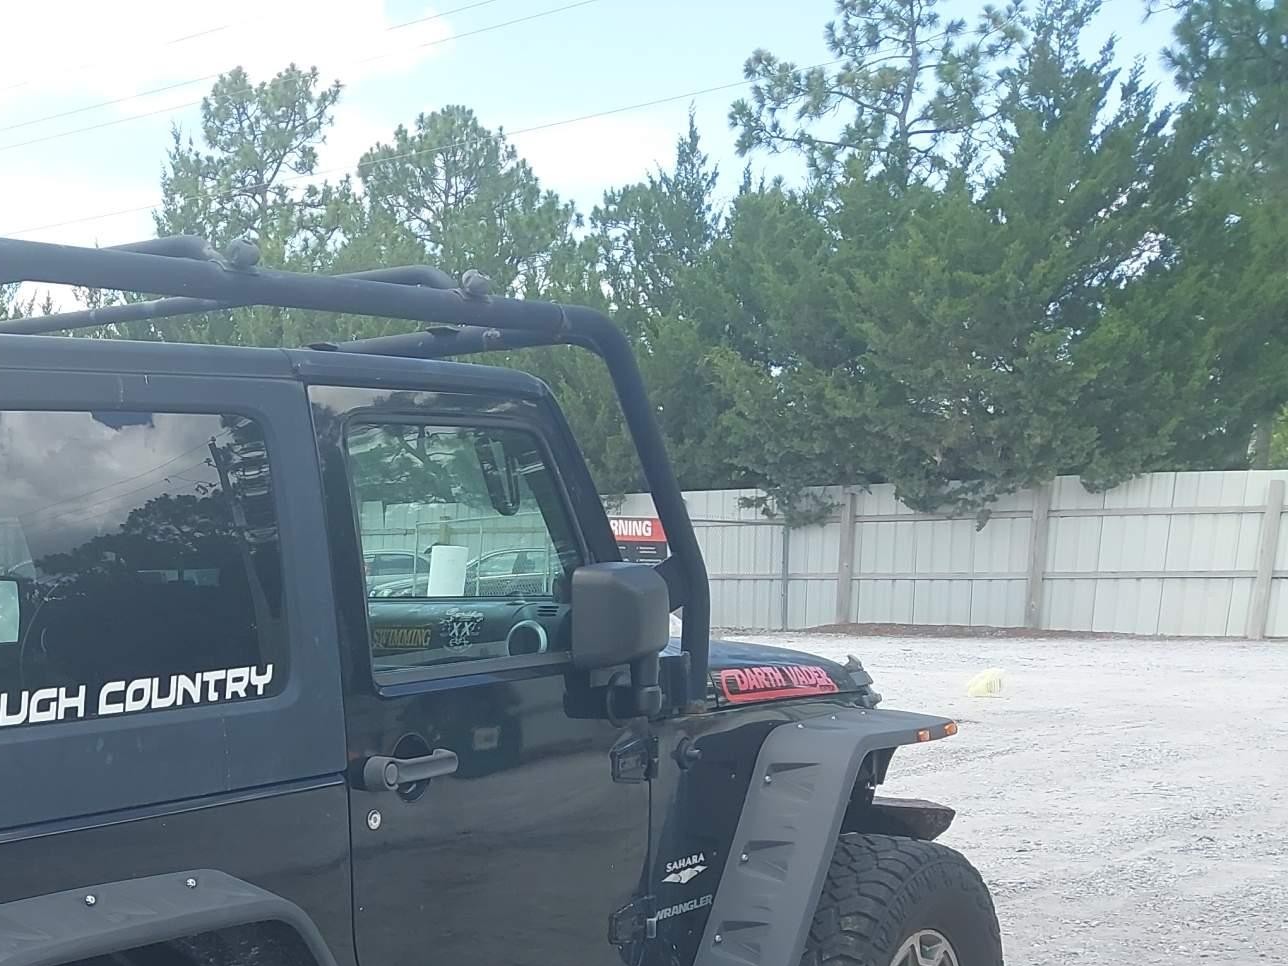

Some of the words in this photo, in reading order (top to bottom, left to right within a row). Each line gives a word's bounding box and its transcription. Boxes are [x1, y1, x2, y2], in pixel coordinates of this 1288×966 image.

[609, 519, 652, 537] RNING
[373, 628, 432, 647] SWIMMING
[98, 664, 273, 715] COUNTRY
[734, 667, 786, 692] DARTH
[782, 665, 833, 689] VADER
[665, 852, 705, 873] SAHARA
[655, 894, 713, 921] WRANGLER
